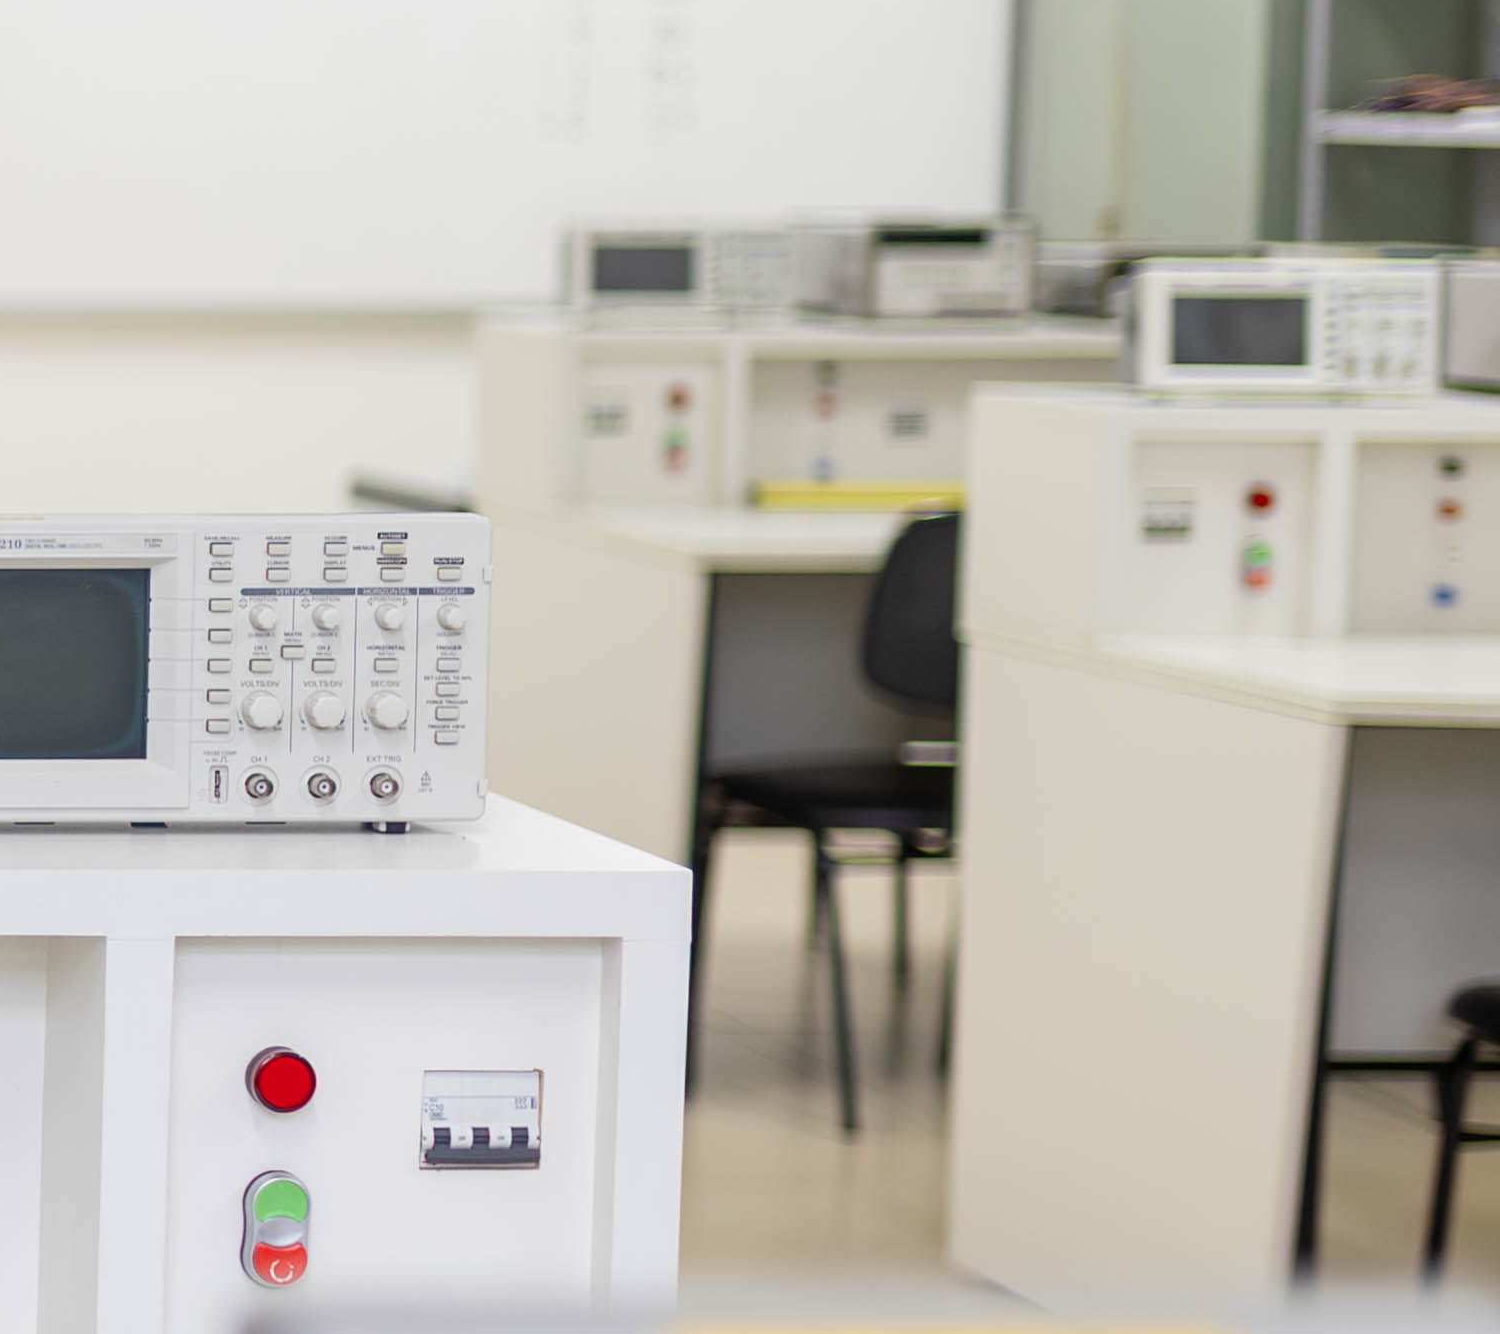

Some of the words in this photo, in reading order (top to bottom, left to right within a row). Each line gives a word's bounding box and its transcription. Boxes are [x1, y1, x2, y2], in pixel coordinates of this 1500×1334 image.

[0, 539, 22, 549] 210
[240, 680, 280, 688] VOLTS/DIV
[303, 680, 343, 688] VOLTS/DIV
[366, 755, 382, 763] EXT
[384, 755, 402, 763] TRIG
